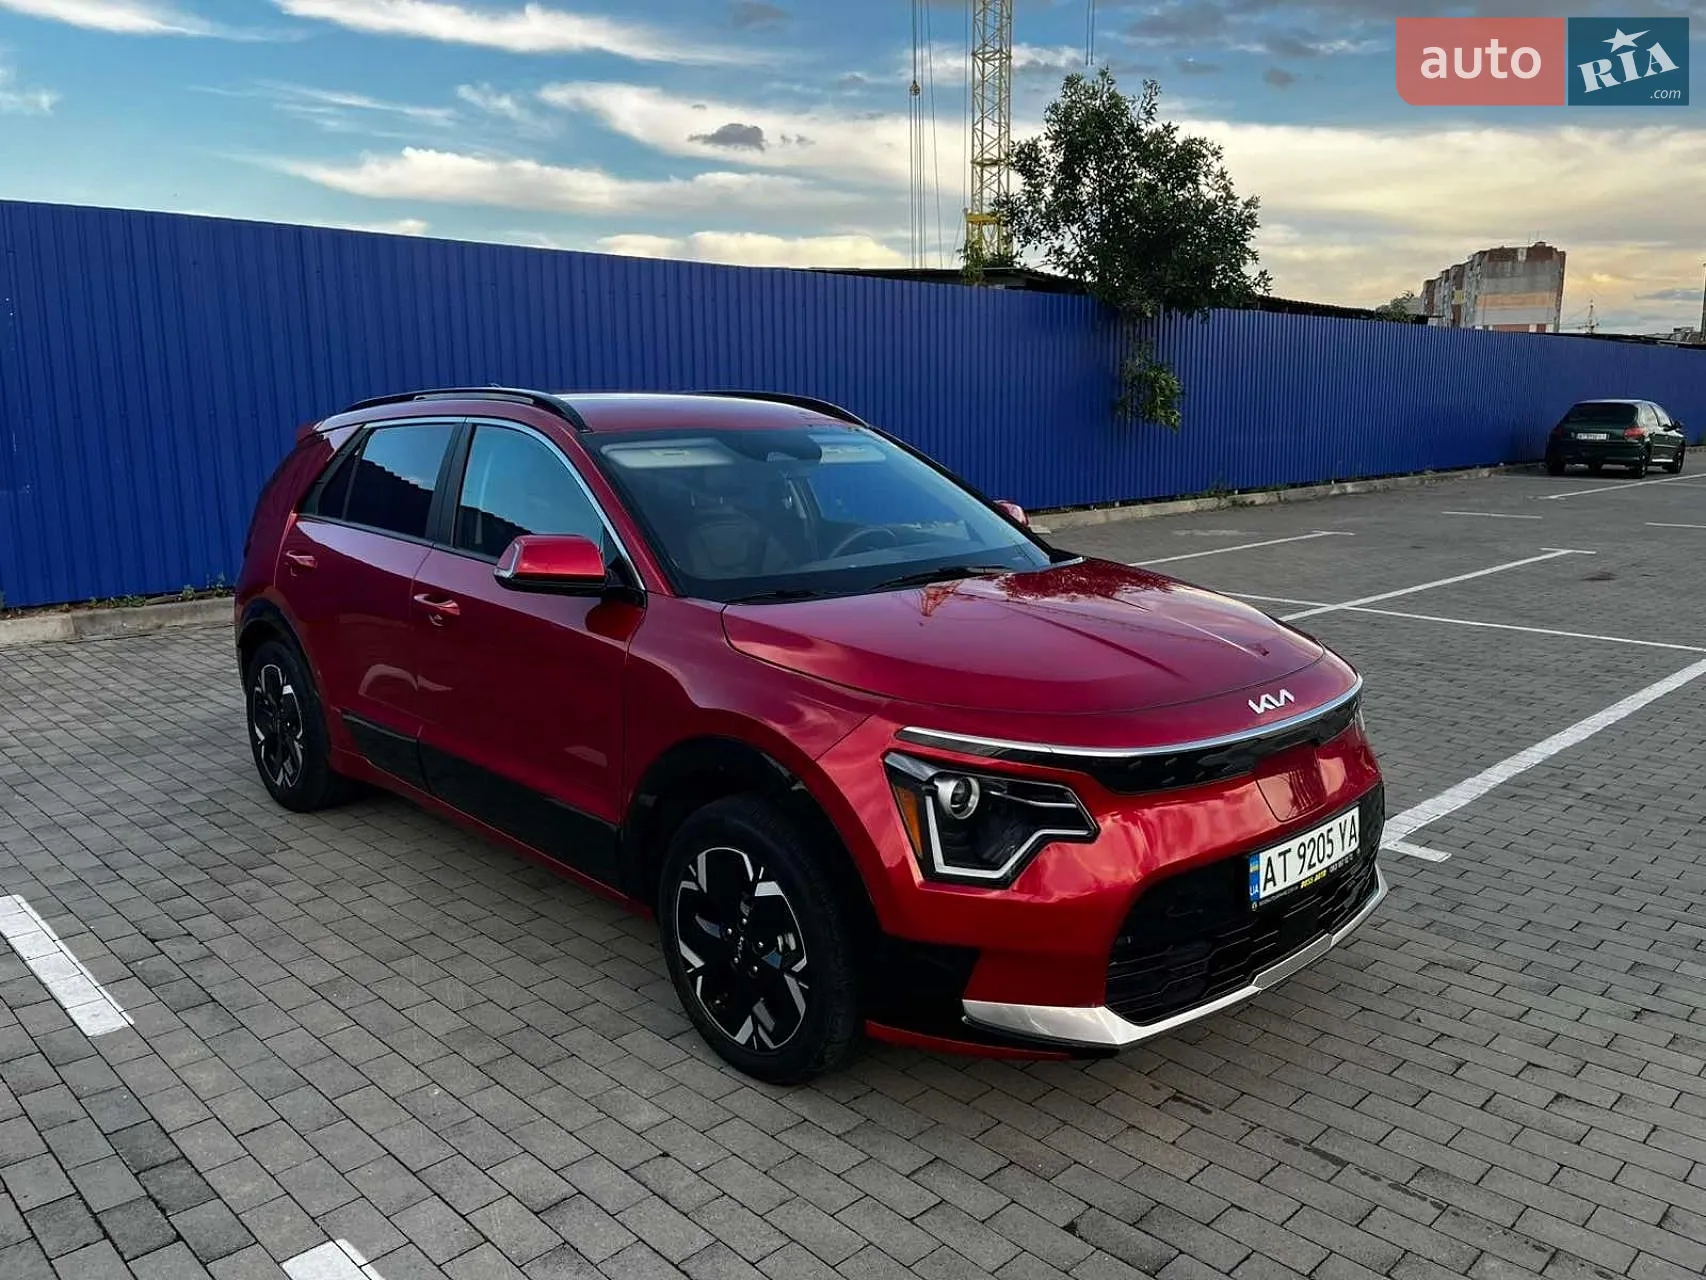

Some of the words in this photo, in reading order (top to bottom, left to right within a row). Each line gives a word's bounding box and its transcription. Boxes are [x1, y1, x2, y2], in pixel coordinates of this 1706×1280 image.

[1248, 688, 1295, 714] KIA
[1263, 848, 1291, 891] AT
[1297, 827, 1334, 875] 9205
[1338, 815, 1358, 851] YA
